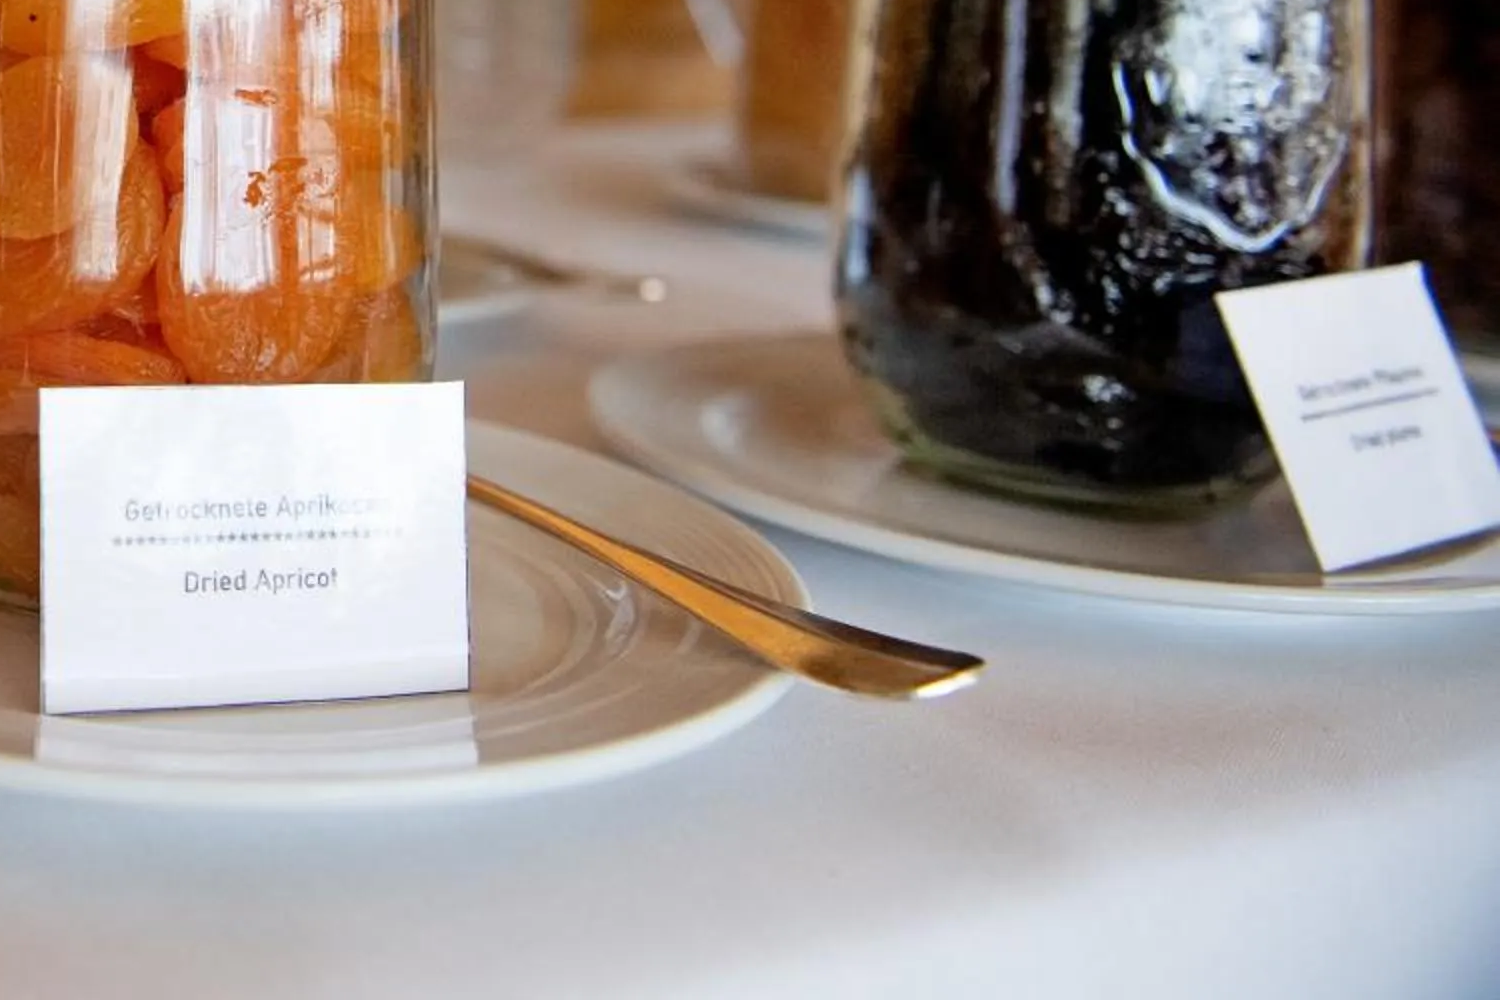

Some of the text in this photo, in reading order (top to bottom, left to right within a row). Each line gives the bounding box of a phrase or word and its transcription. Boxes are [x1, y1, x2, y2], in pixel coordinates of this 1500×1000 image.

[275, 492, 387, 521] Aprik
[183, 566, 338, 595] Dried Apricot
